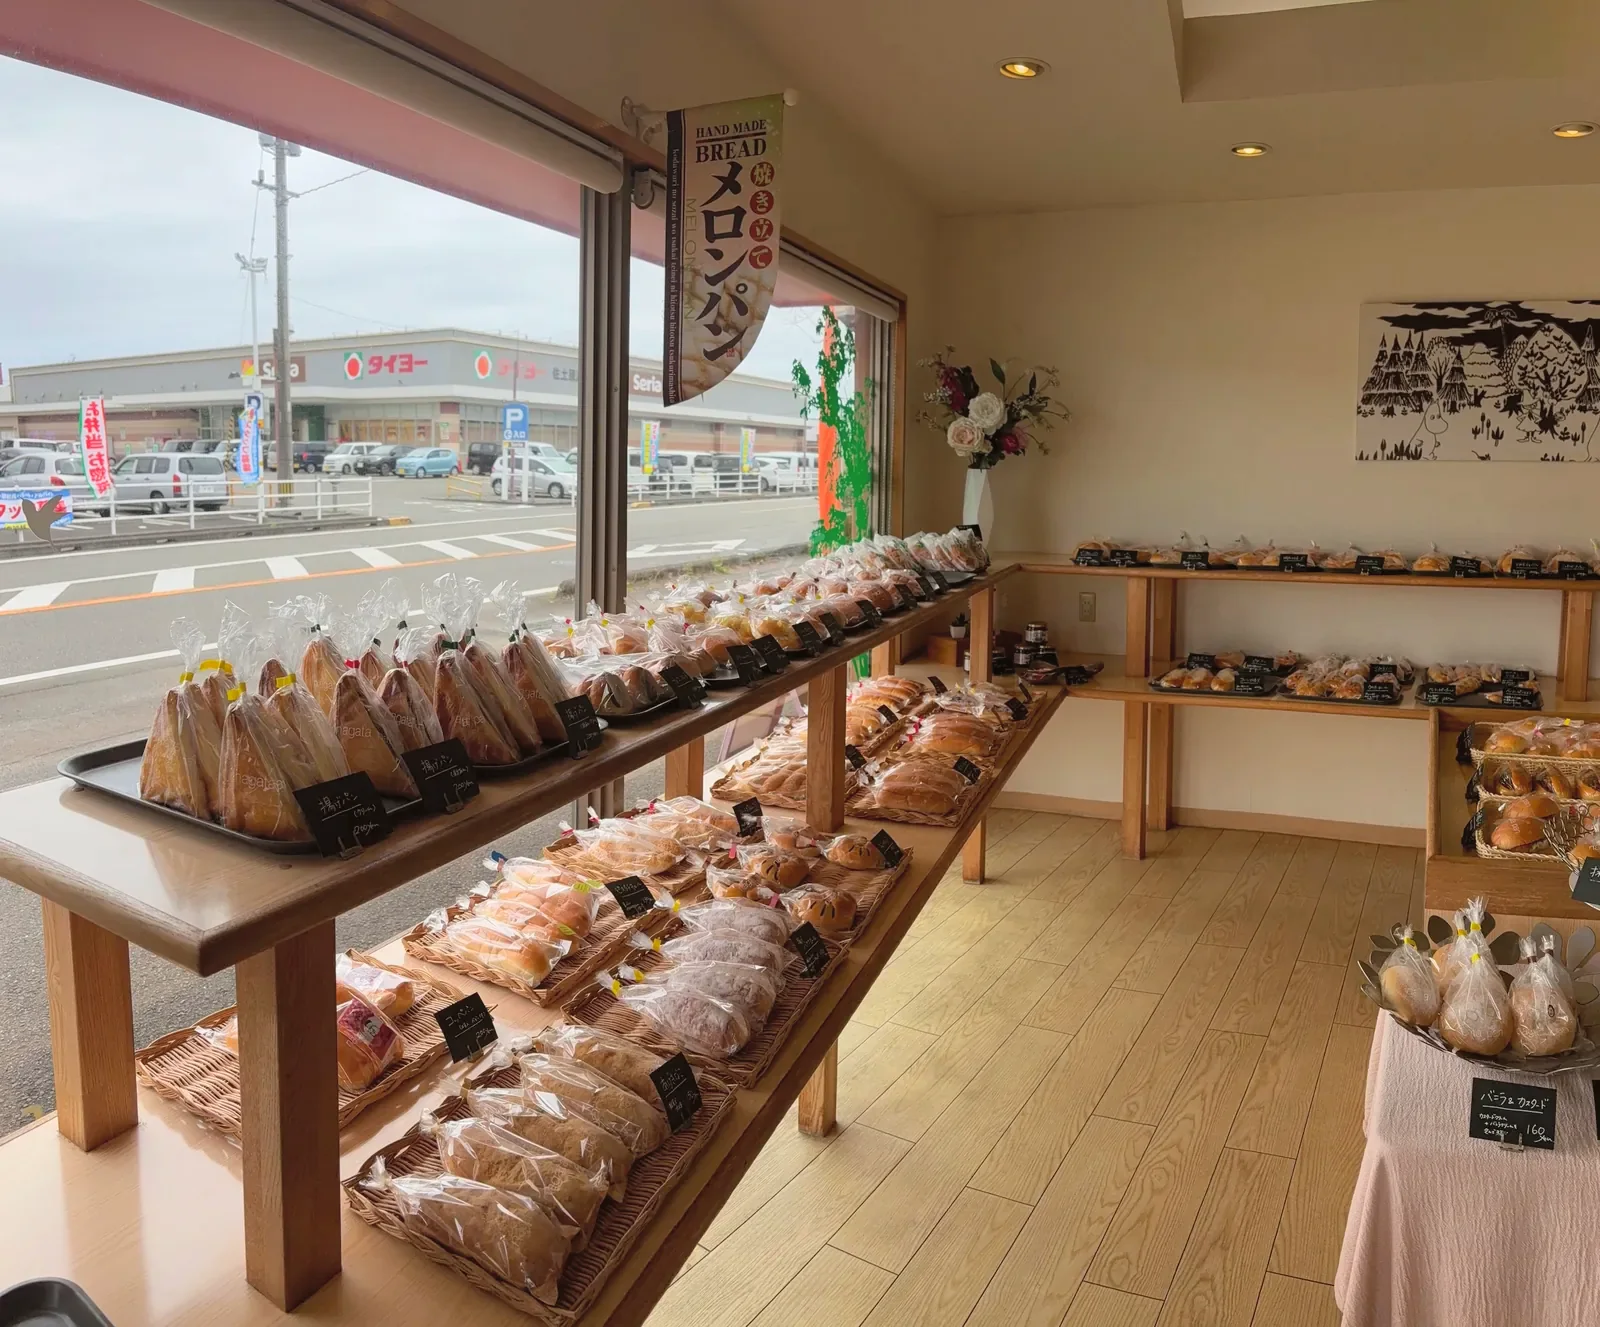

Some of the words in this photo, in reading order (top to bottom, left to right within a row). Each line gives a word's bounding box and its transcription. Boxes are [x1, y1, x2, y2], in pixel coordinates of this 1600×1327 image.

[696, 125, 729, 138] HAND
[733, 119, 767, 134] MADE
[696, 138, 767, 163] BREAD
[752, 163, 773, 267] 焼き立て
[695, 161, 748, 361] メロンパン
[368, 353, 428, 375] タイヨー
[633, 374, 662, 393] Seria
[505, 408, 524, 429] P
[318, 791, 358, 814] 揚げパン
[1526, 1124, 1546, 1135] 160
